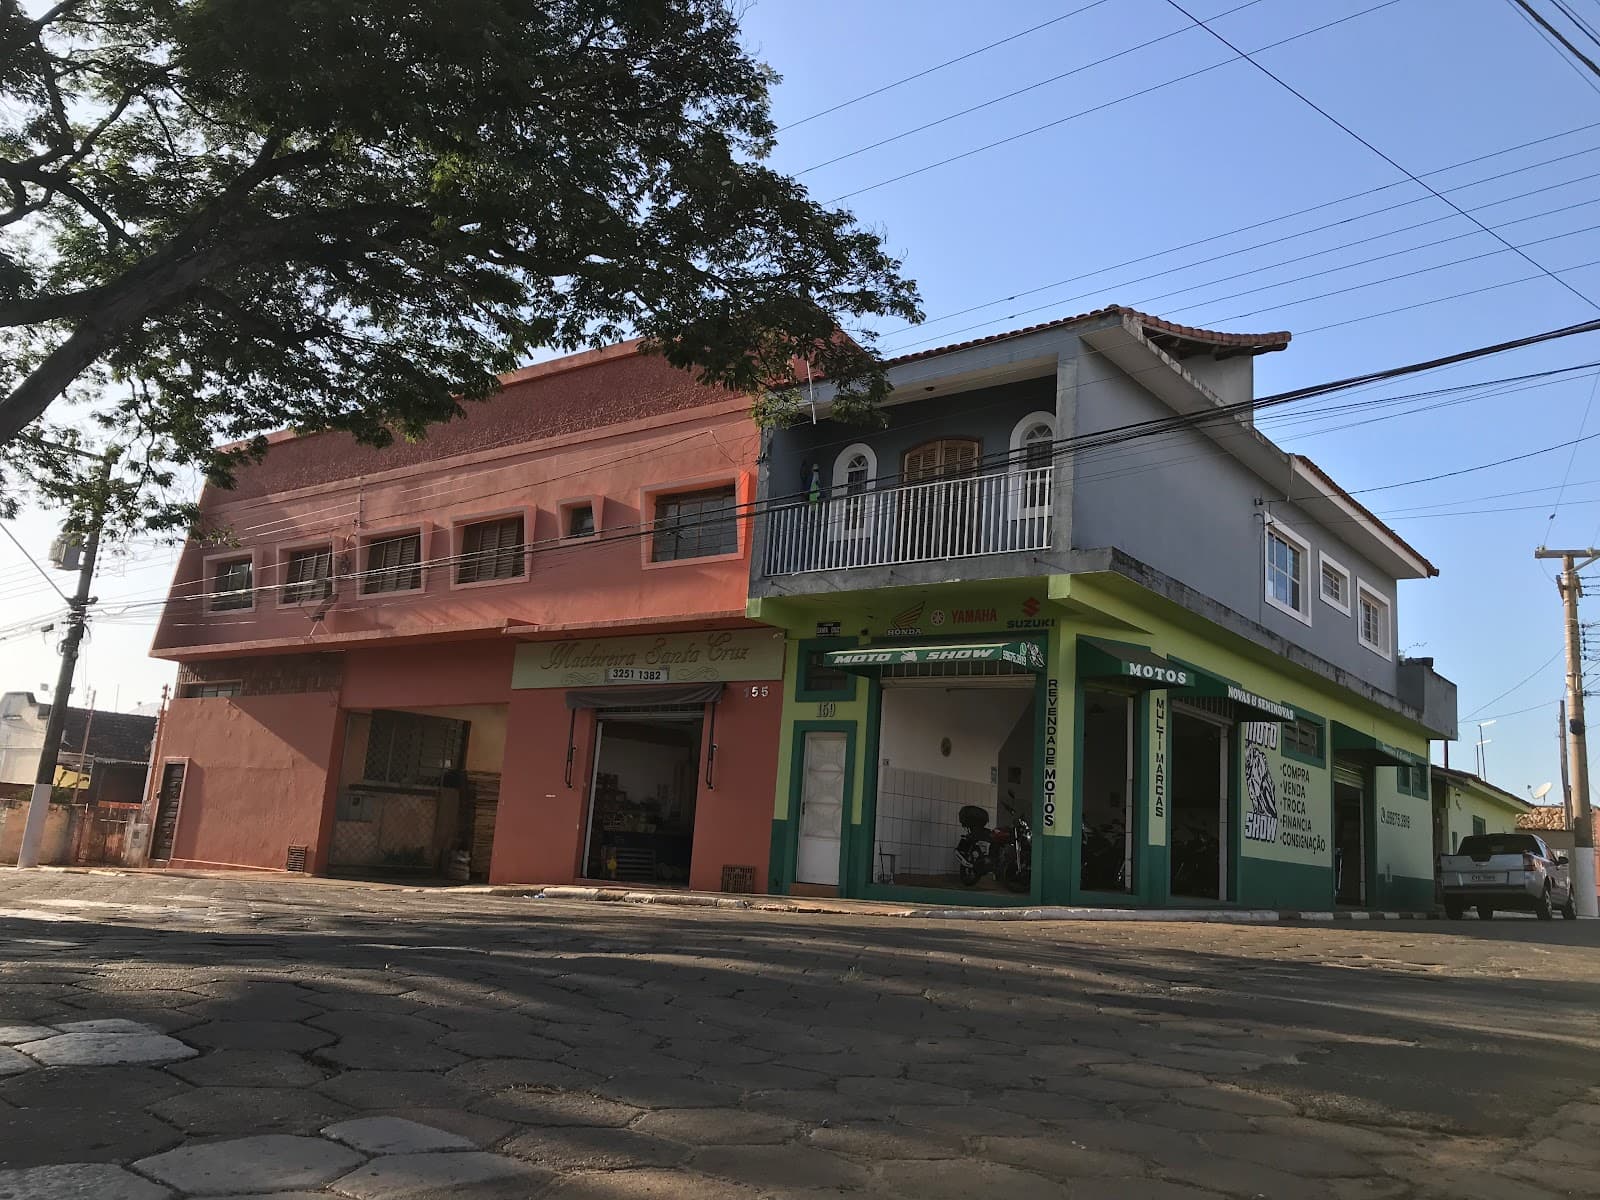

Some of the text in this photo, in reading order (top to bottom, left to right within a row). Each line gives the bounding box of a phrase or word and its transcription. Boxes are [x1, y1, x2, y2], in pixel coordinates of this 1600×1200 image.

[951, 608, 997, 624] YAMAHA
[1006, 618, 1055, 629] SUZUKI
[887, 628, 922, 636] HONDA
[647, 638, 700, 665] Santa
[707, 632, 750, 661] Cruz
[834, 649, 994, 664] MOTO SHOW
[612, 669, 661, 680] 3251 1382
[1129, 662, 1187, 685] MOTOS
[1228, 685, 1250, 704] NOVAS
[1257, 697, 1294, 720] SEMINOVAS
[1245, 721, 1278, 750] MOTO
[1044, 679, 1058, 827] REVENDA DE MOTOS
[1155, 697, 1165, 818] MULTI MARCAS
[1282, 763, 1310, 784] COMPRA
[1282, 780, 1306, 799] VENDA
[1282, 797, 1306, 816] TROCA
[1244, 811, 1278, 843] SHOW
[1282, 814, 1312, 833] FINANCIA
[1282, 832, 1326, 855] CONSIGNAÇÃO
